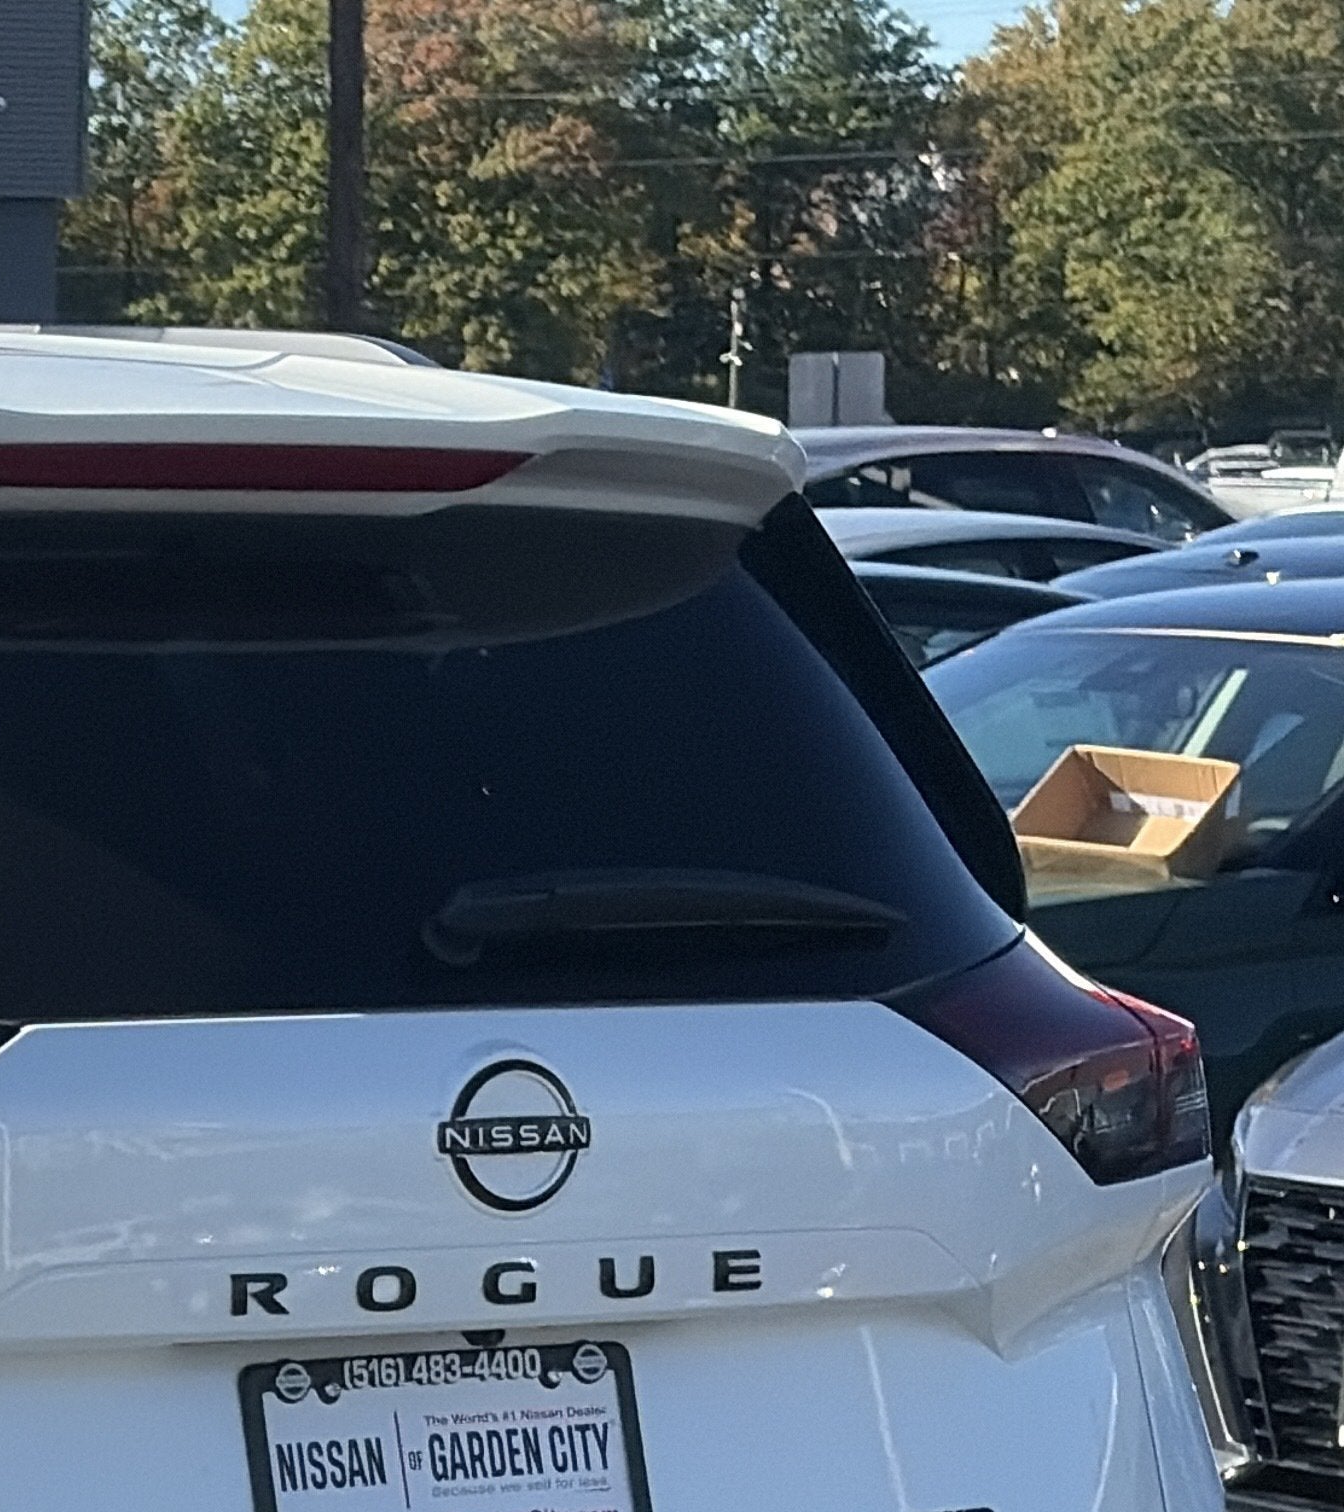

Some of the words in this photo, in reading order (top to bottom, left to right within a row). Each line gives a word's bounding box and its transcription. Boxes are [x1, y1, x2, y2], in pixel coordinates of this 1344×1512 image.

[444, 1122, 589, 1150] NISSAN
[229, 1249, 762, 1316] ROGUE
[343, 1357, 406, 1389] (516)
[412, 1349, 542, 1385] 483-4400
[520, 1409, 563, 1420] Nissan
[275, 1436, 387, 1492] NISSAN
[408, 1450, 423, 1471] OF
[428, 1427, 544, 1482] GARDEN
[548, 1422, 609, 1473] CITY
